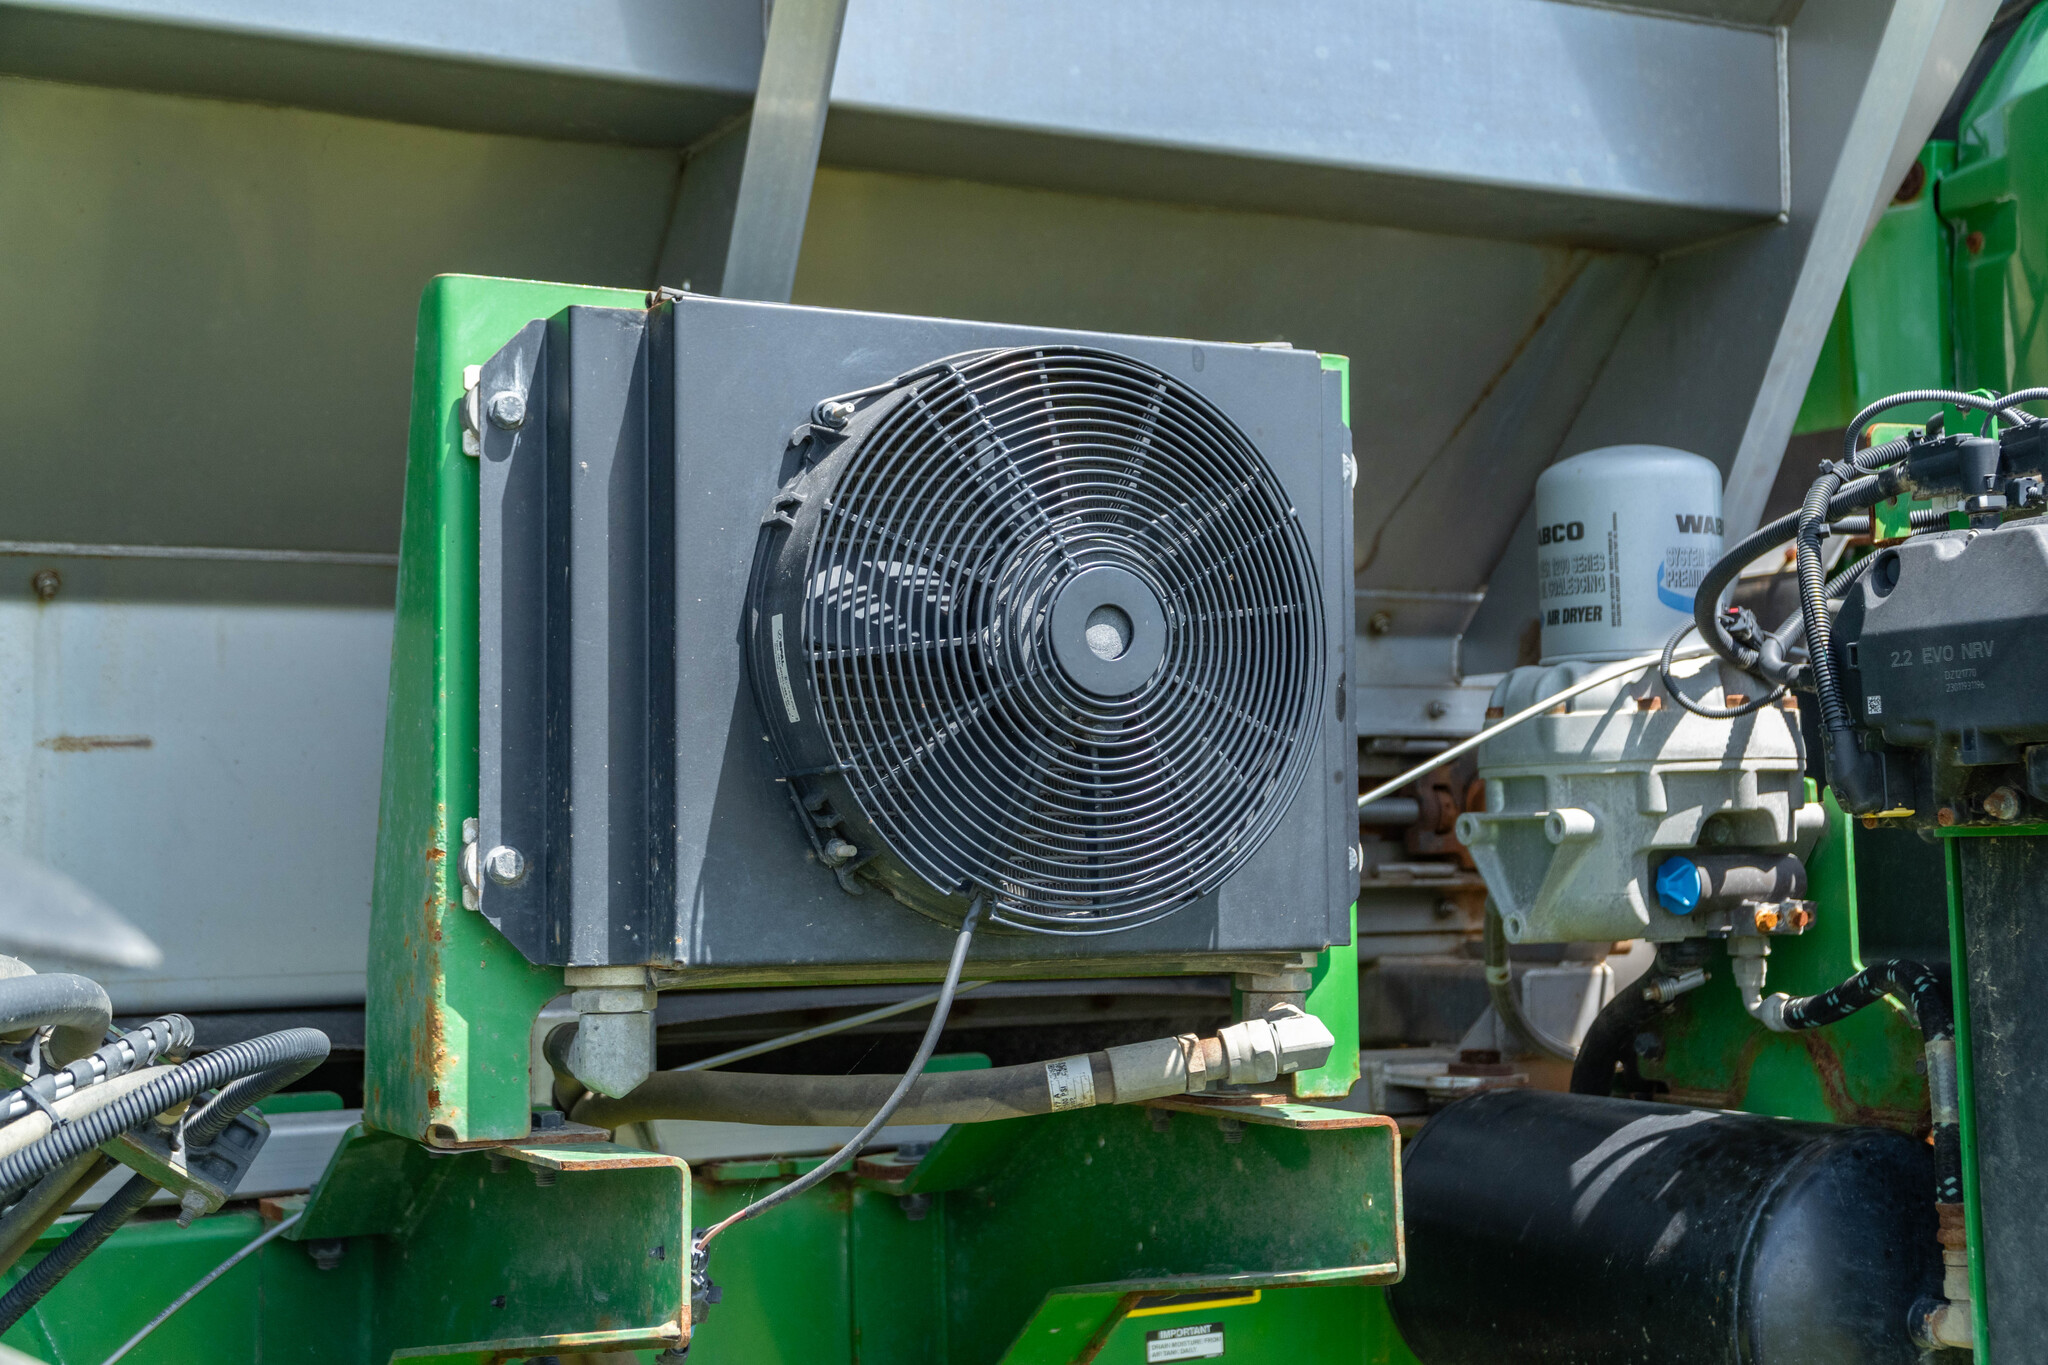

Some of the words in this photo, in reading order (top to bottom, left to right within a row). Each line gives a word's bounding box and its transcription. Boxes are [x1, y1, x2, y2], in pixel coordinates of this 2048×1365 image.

[1572, 553, 1605, 574] SERIES
[1547, 608, 1560, 626] AIR
[1562, 605, 1602, 624] DRYER
[1890, 650, 1913, 668] 2.2
[1922, 645, 1954, 664] EVO
[1961, 640, 1994, 660] NRV
[1159, 1324, 1212, 1339] IMPORTANT
[1151, 1341, 1171, 1351] DRAIN
[1172, 1338, 1204, 1349] MOISTURE
